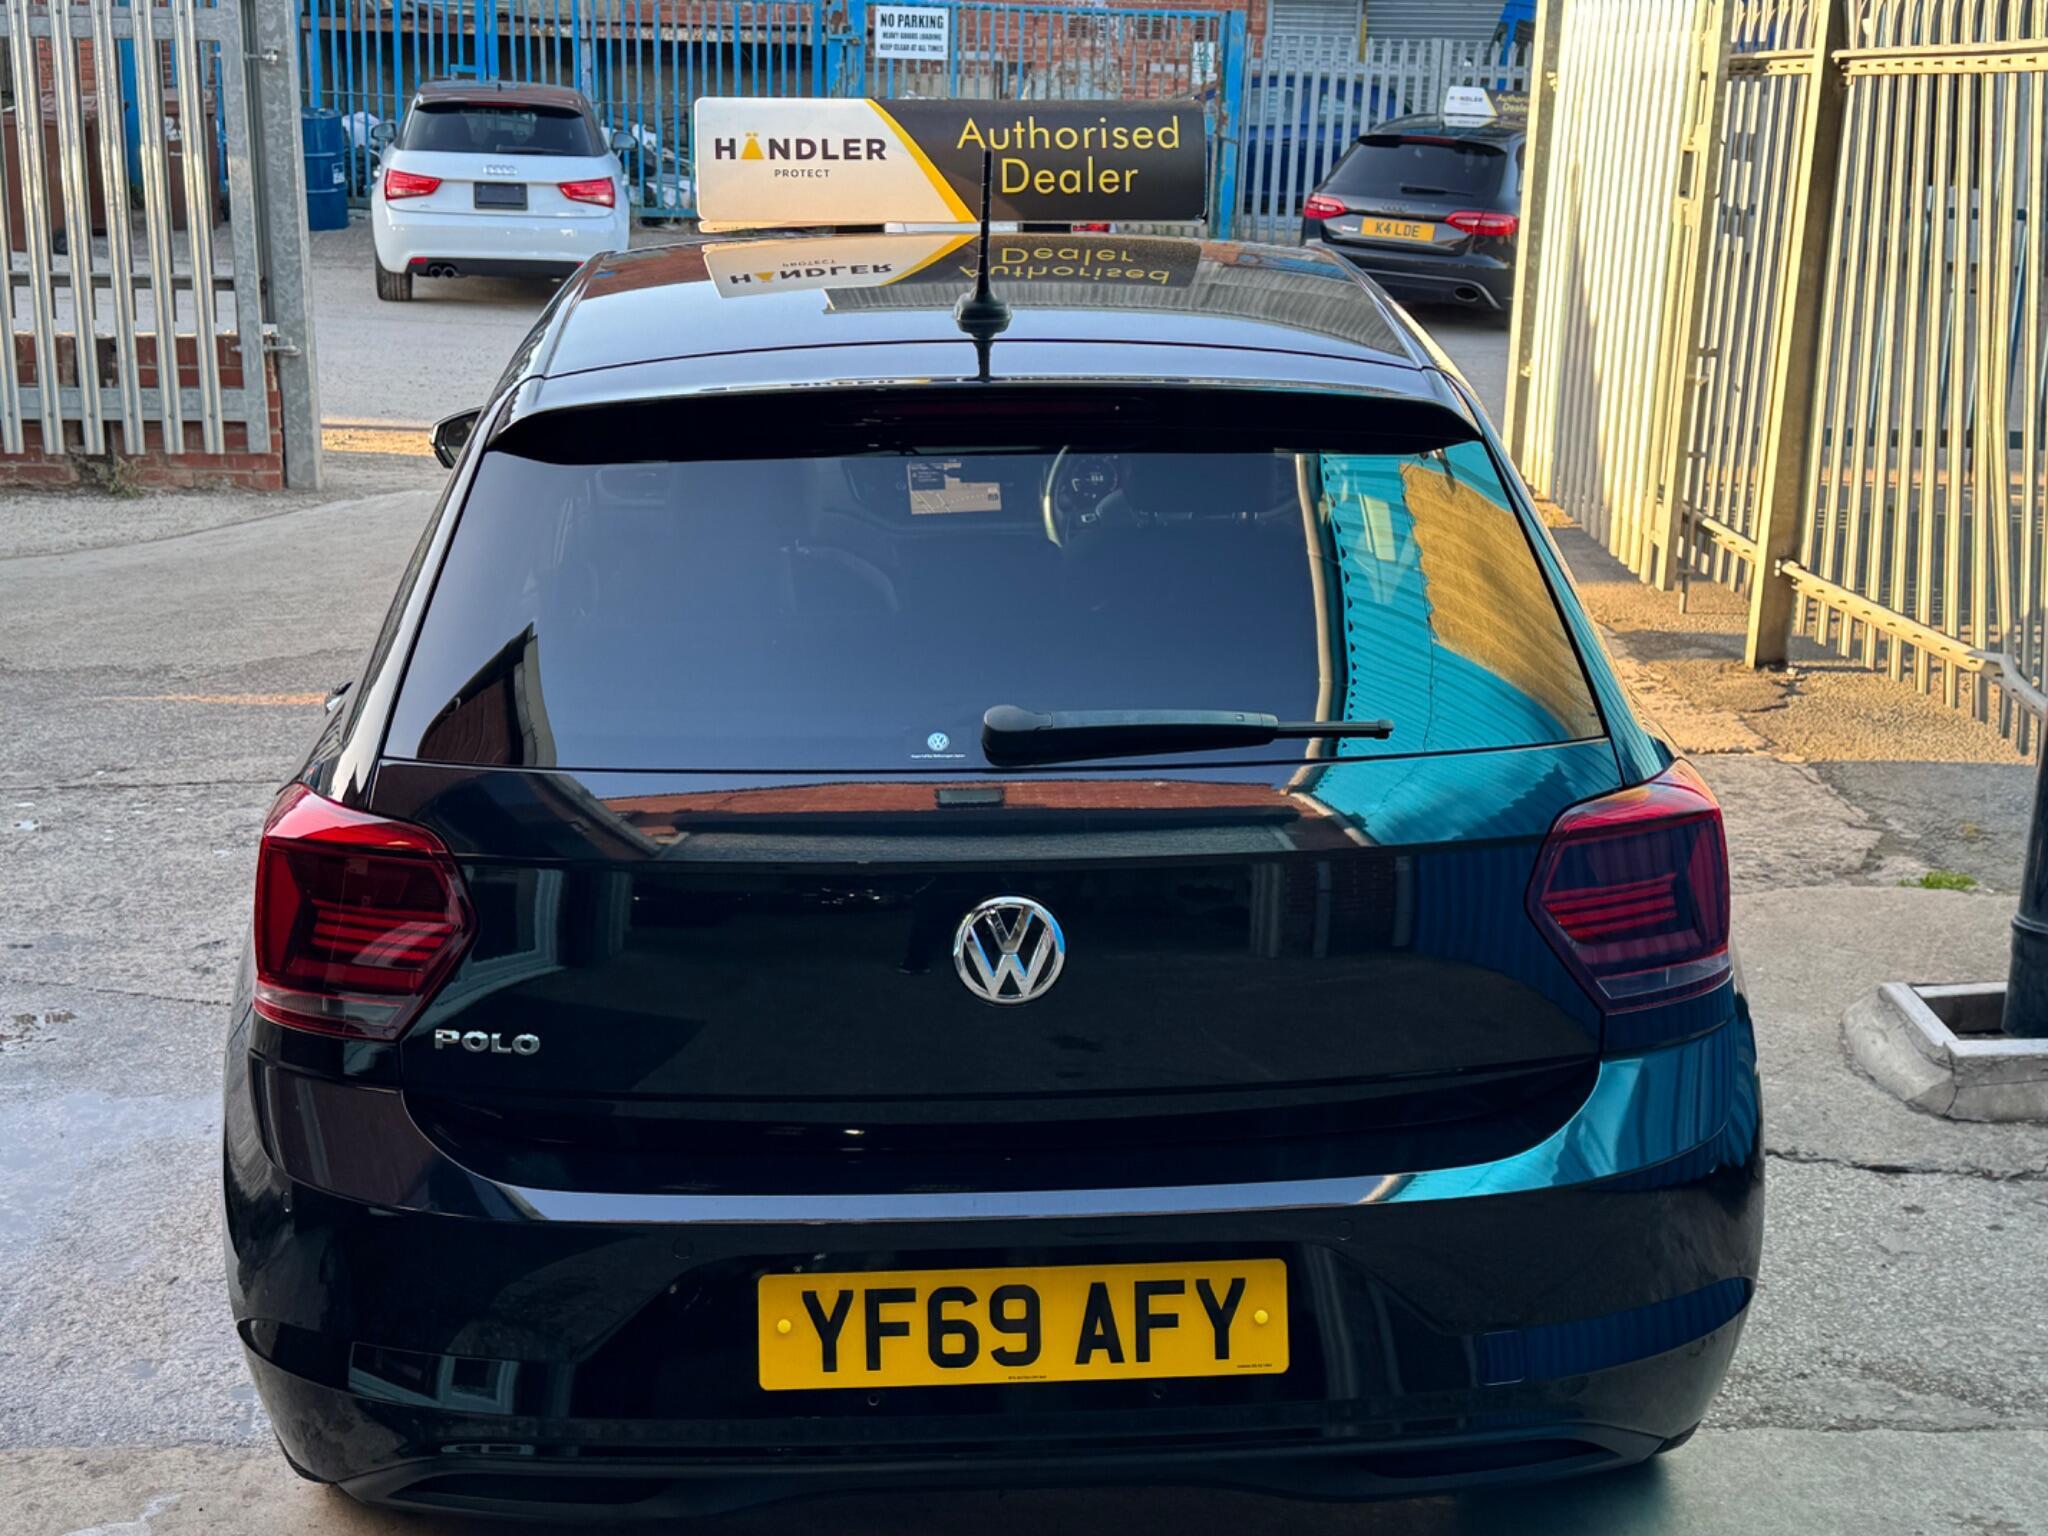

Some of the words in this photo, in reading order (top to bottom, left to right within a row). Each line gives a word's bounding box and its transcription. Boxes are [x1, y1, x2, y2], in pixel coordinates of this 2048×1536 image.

[880, 13, 895, 28] NO
[897, 14, 944, 29] PARKING
[956, 115, 1180, 150] Authorised
[774, 168, 830, 178] PROTECT
[1001, 156, 1139, 194] Dealer
[1375, 222, 1392, 234] K4
[1395, 224, 1421, 238] LDE
[434, 1029, 541, 1056] POLO
[801, 1283, 1042, 1373] YF69
[1074, 1277, 1247, 1365] AFY
